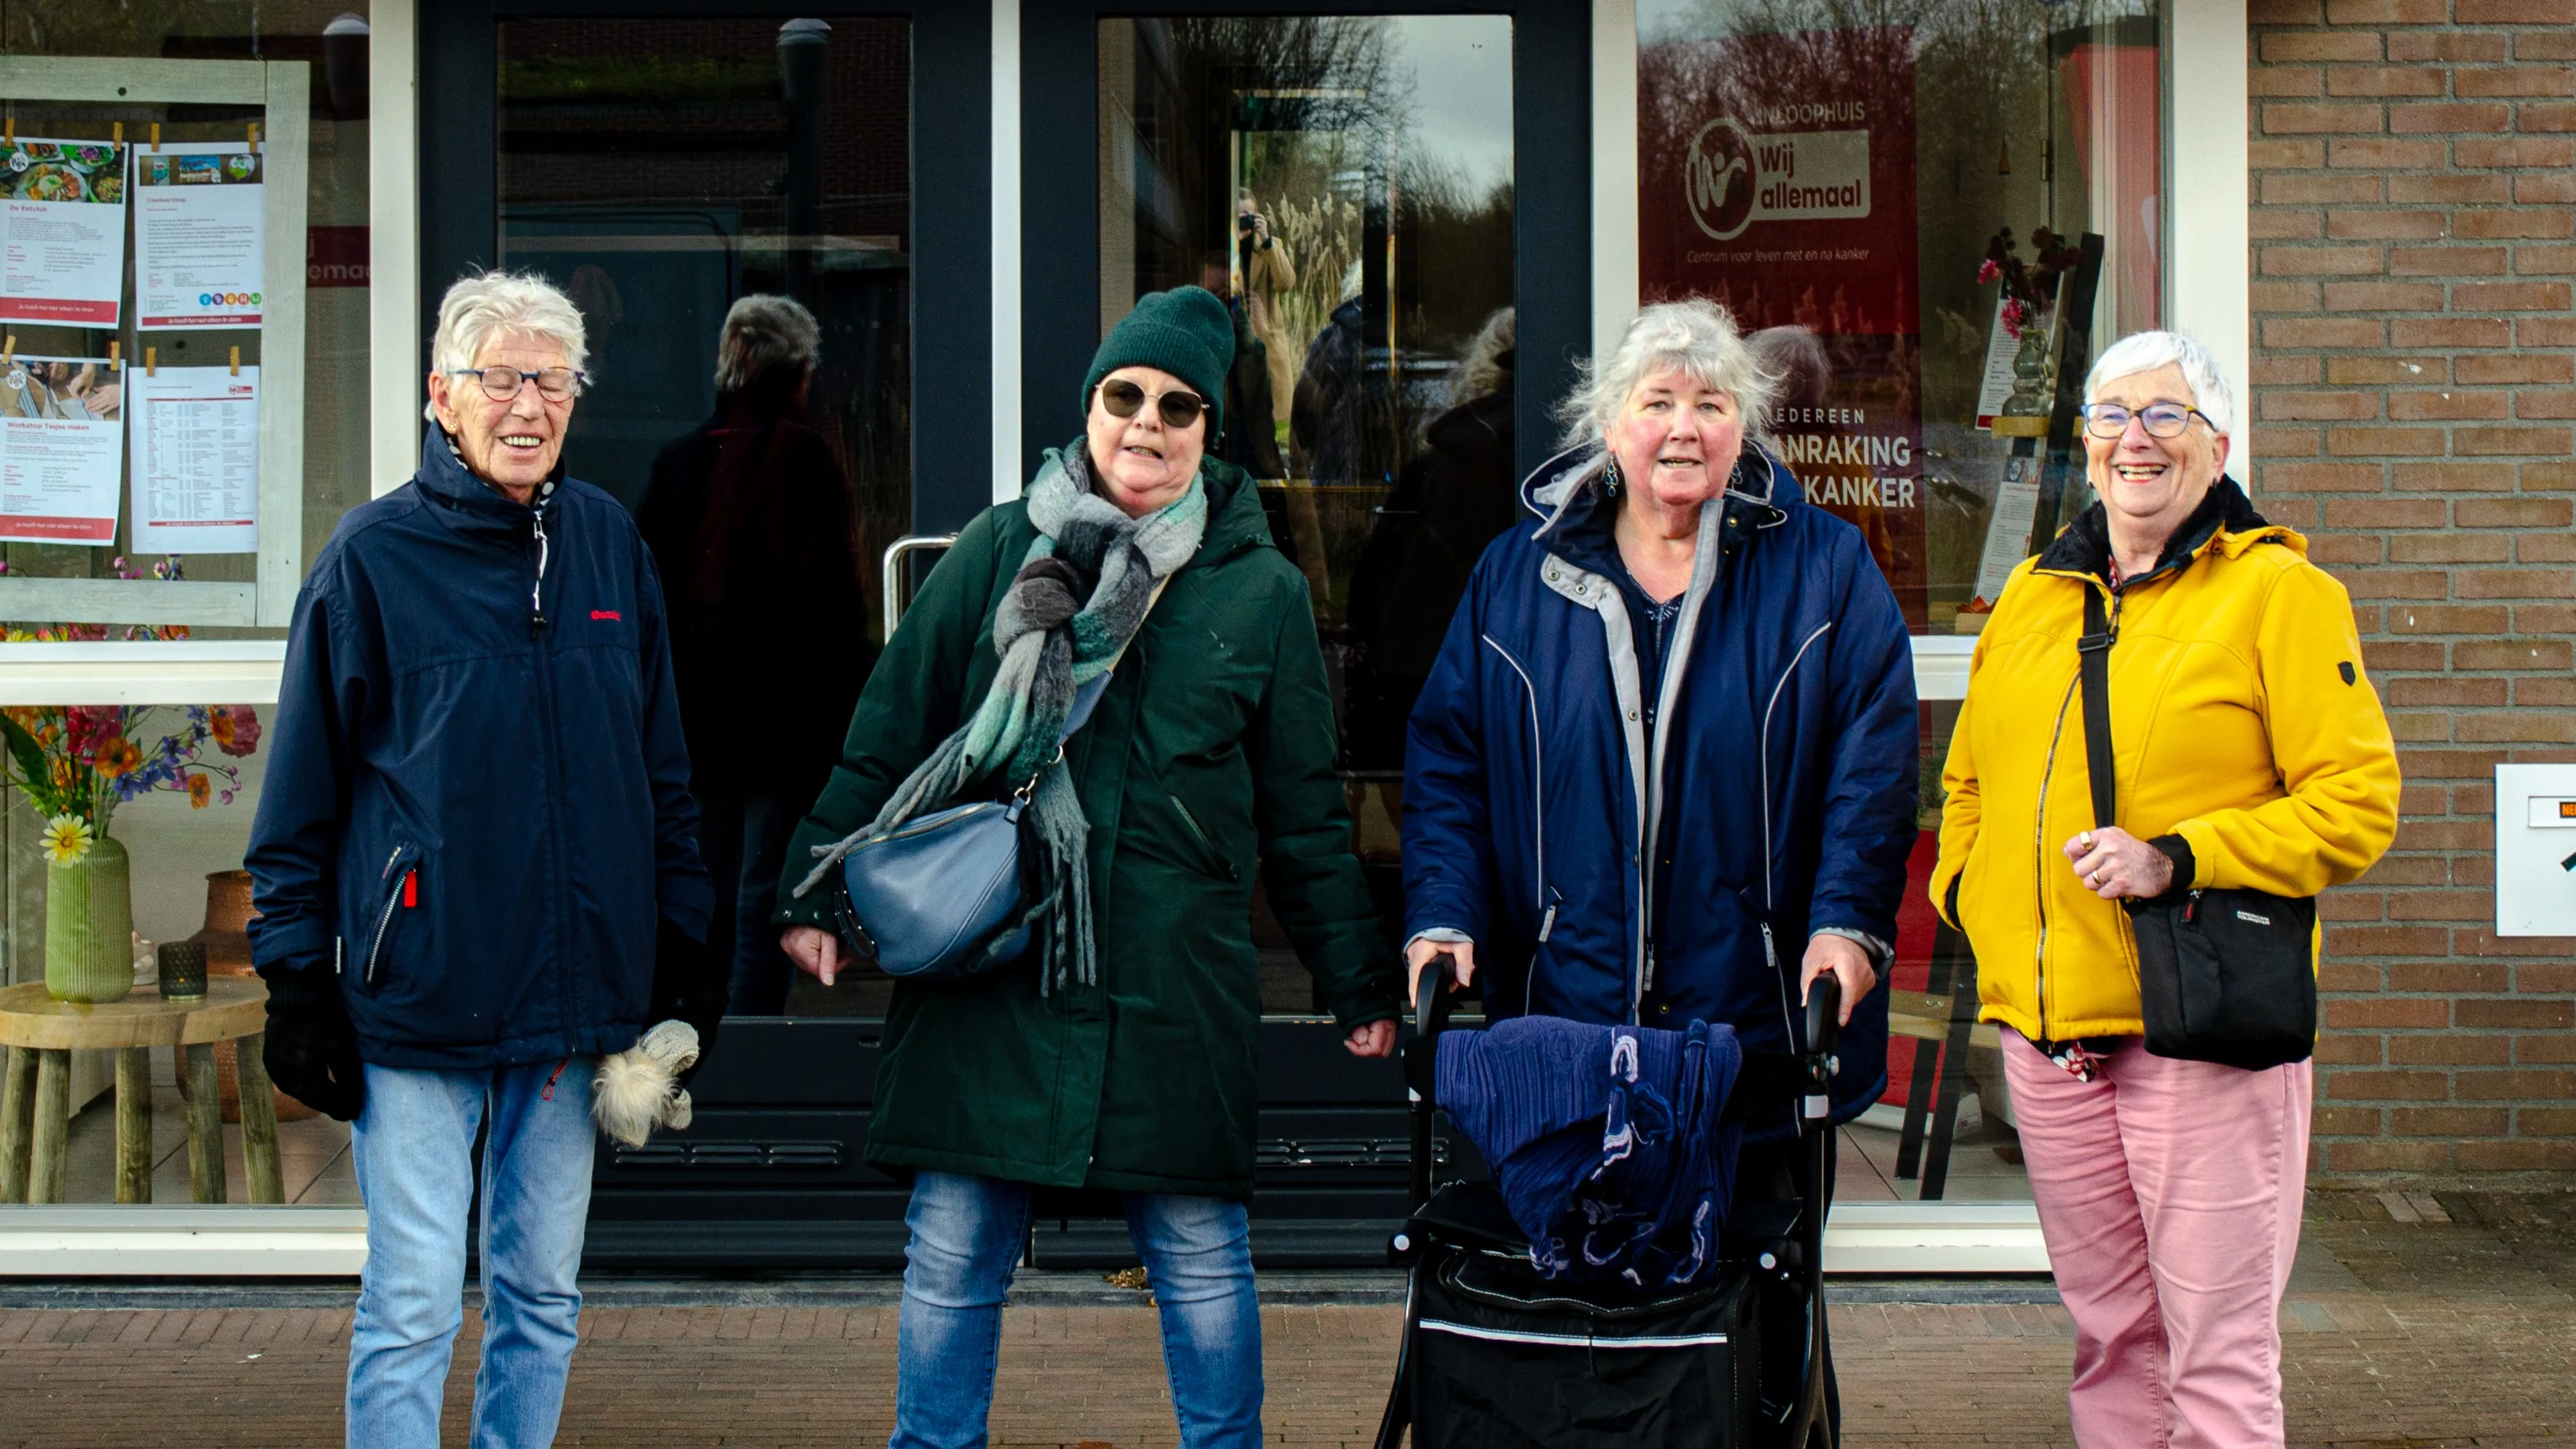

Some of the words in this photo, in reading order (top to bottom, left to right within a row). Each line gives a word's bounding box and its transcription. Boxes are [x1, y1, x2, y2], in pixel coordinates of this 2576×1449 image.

[1759, 142, 1795, 179] Wij
[1761, 179, 1861, 209] allemaal
[1687, 251, 1728, 263] Centrum
[1731, 252, 1753, 262] voor
[1755, 249, 1781, 262] leven
[1784, 251, 1803, 262] met
[1805, 251, 1817, 261] en
[1820, 251, 1833, 260] na
[1836, 248, 1870, 260] kanker
[1777, 408, 1864, 423] EDEREEN
[1775, 434, 1911, 466] NRAKING
[1804, 475, 1915, 508] KANKER
[2562, 804, 2576, 816] NE
